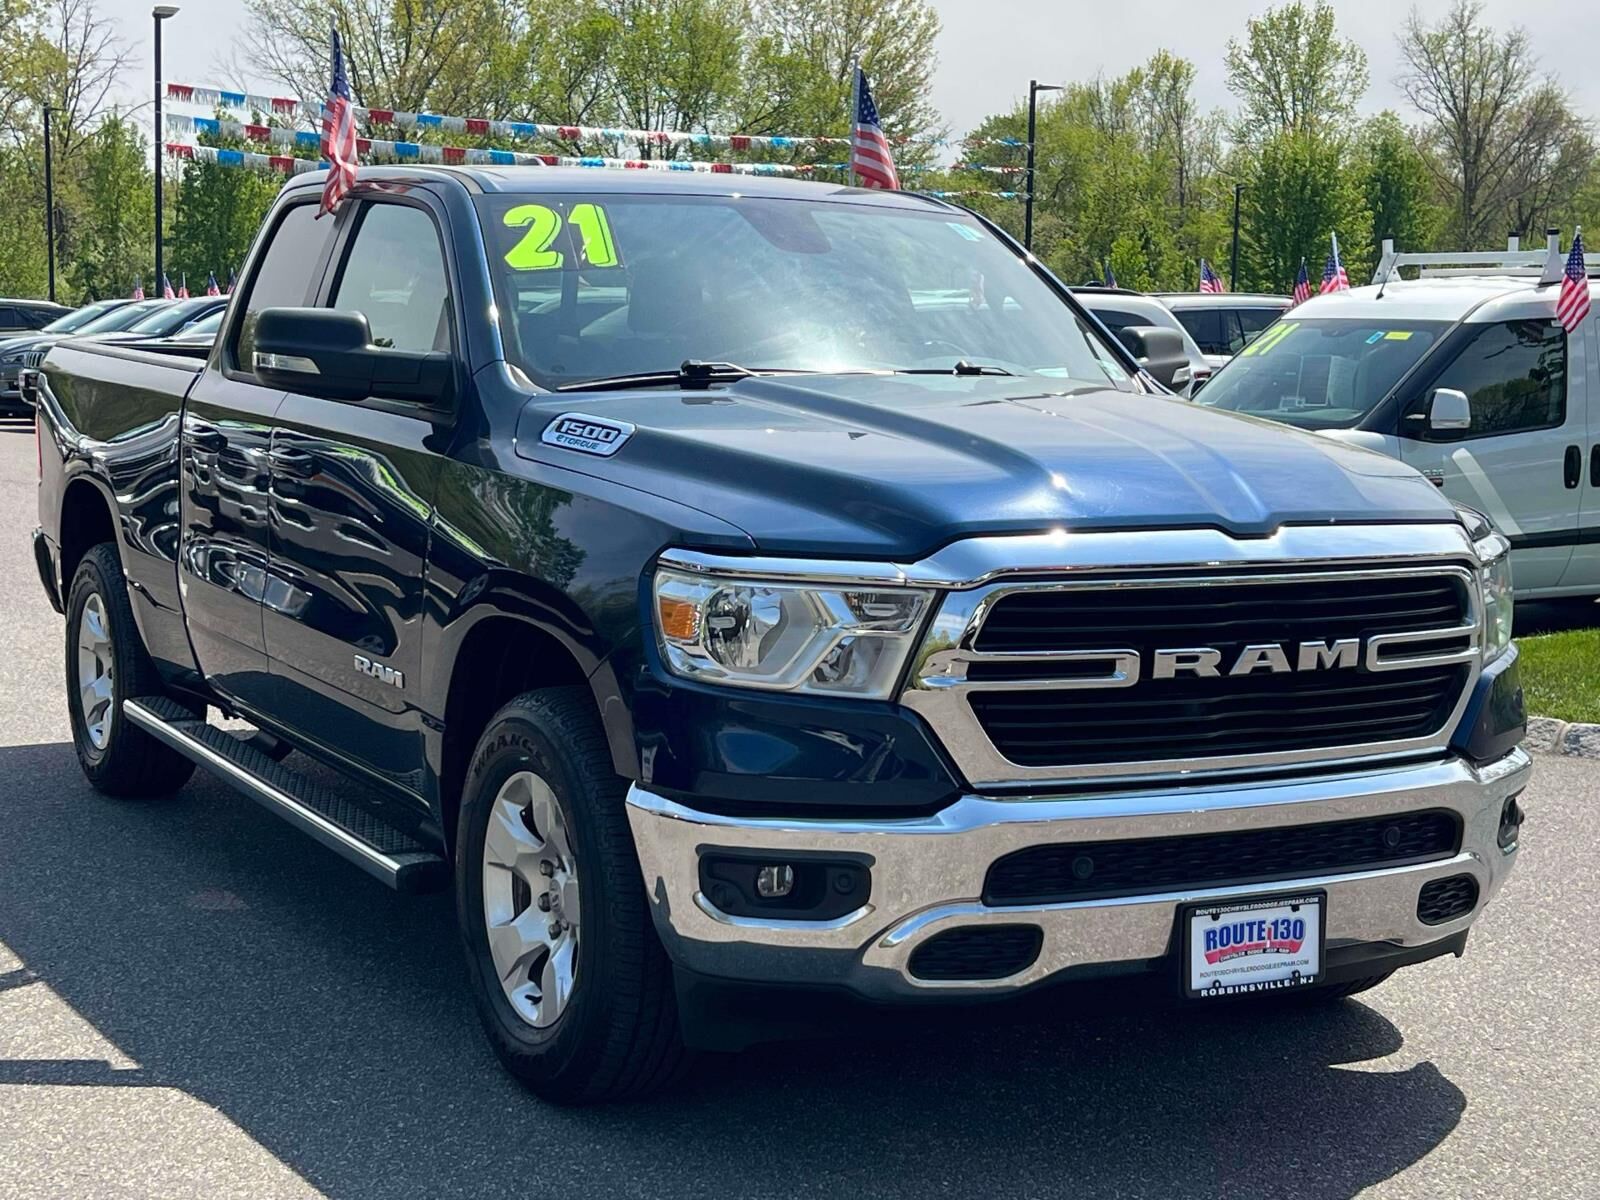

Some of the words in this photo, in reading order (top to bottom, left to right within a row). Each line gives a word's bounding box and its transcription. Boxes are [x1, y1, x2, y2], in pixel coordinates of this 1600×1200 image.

[503, 203, 618, 271] 21
[1242, 322, 1300, 356] 21
[560, 420, 619, 442] 1500
[354, 654, 405, 689] RAM
[1152, 638, 1360, 679] RAM
[1205, 919, 1266, 951] ROUTE
[1270, 918, 1304, 940] 130
[1300, 975, 1314, 985] NJ
